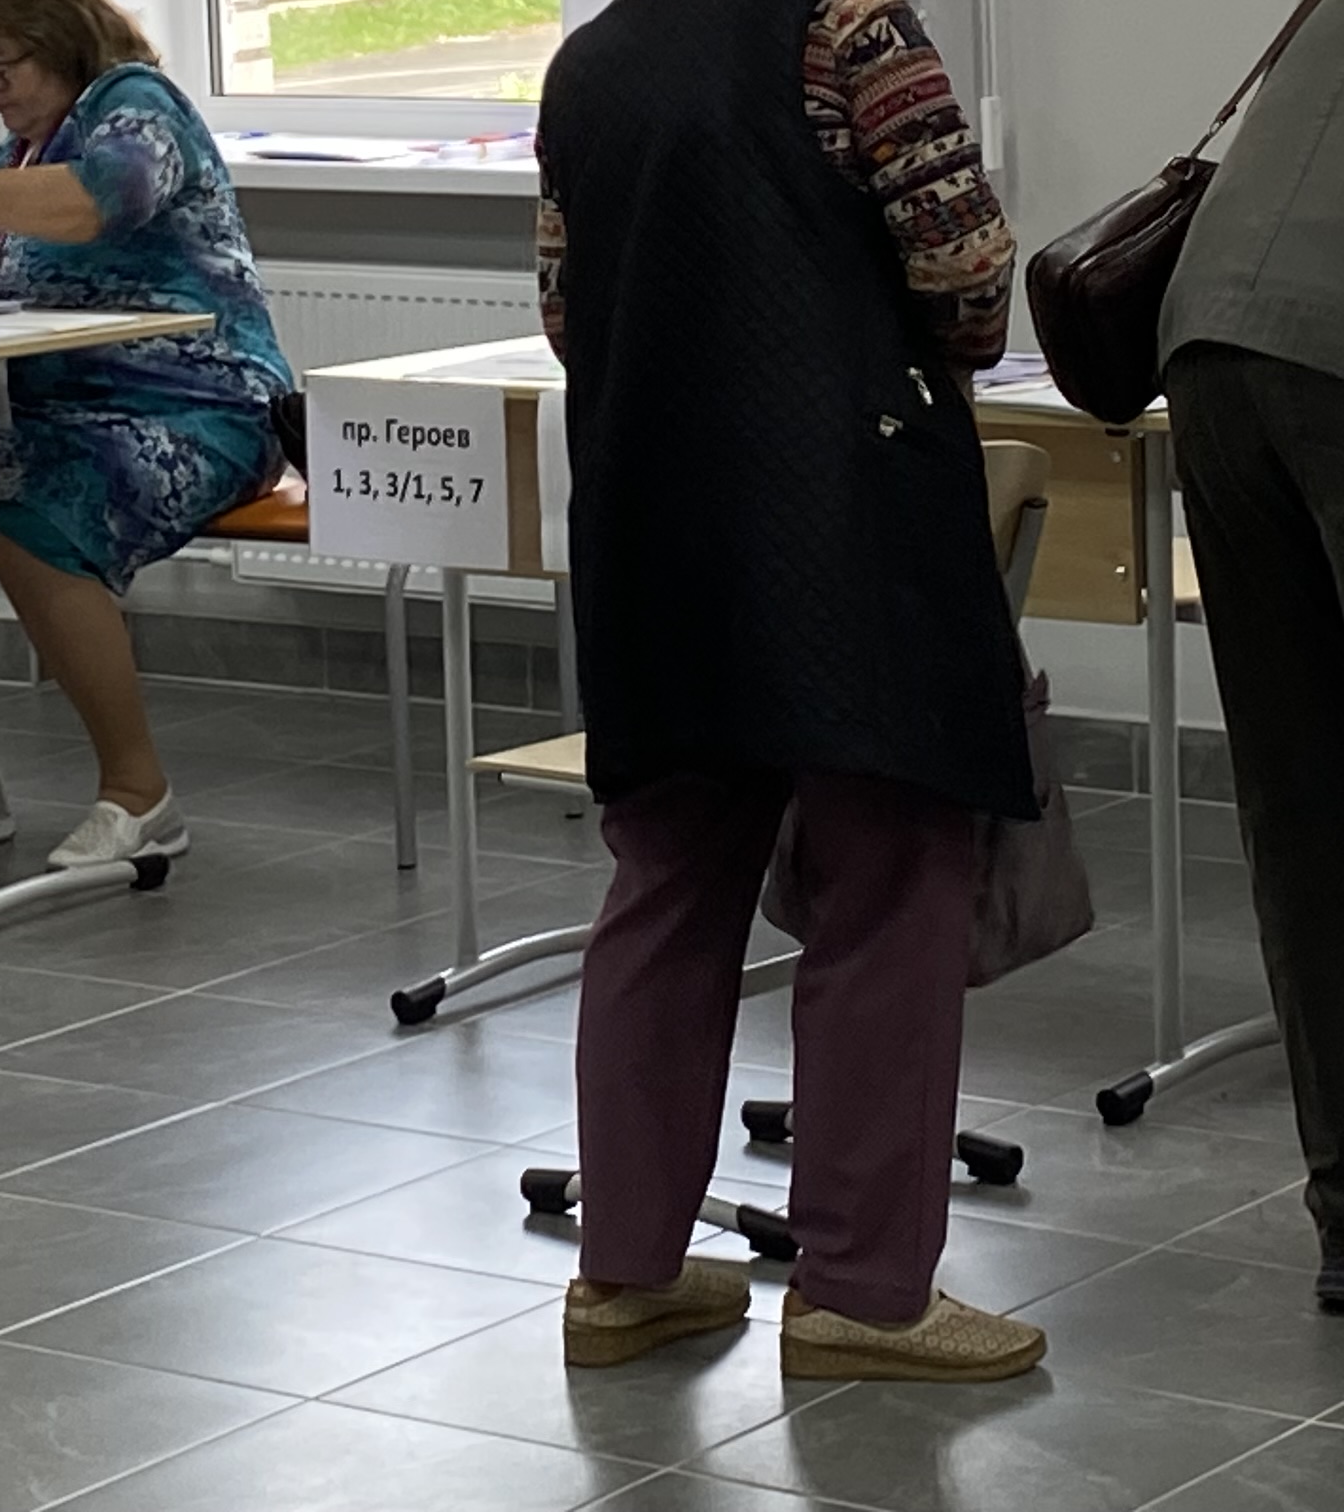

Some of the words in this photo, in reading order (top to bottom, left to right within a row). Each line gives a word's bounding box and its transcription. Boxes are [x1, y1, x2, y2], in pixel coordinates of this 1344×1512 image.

[342, 421, 377, 447] пр.
[385, 419, 471, 451] Героев
[333, 469, 352, 498] 1,
[359, 470, 379, 500] 3,
[386, 471, 432, 505] 3/1,
[440, 476, 462, 507] 5,
[469, 478, 484, 503] 7
